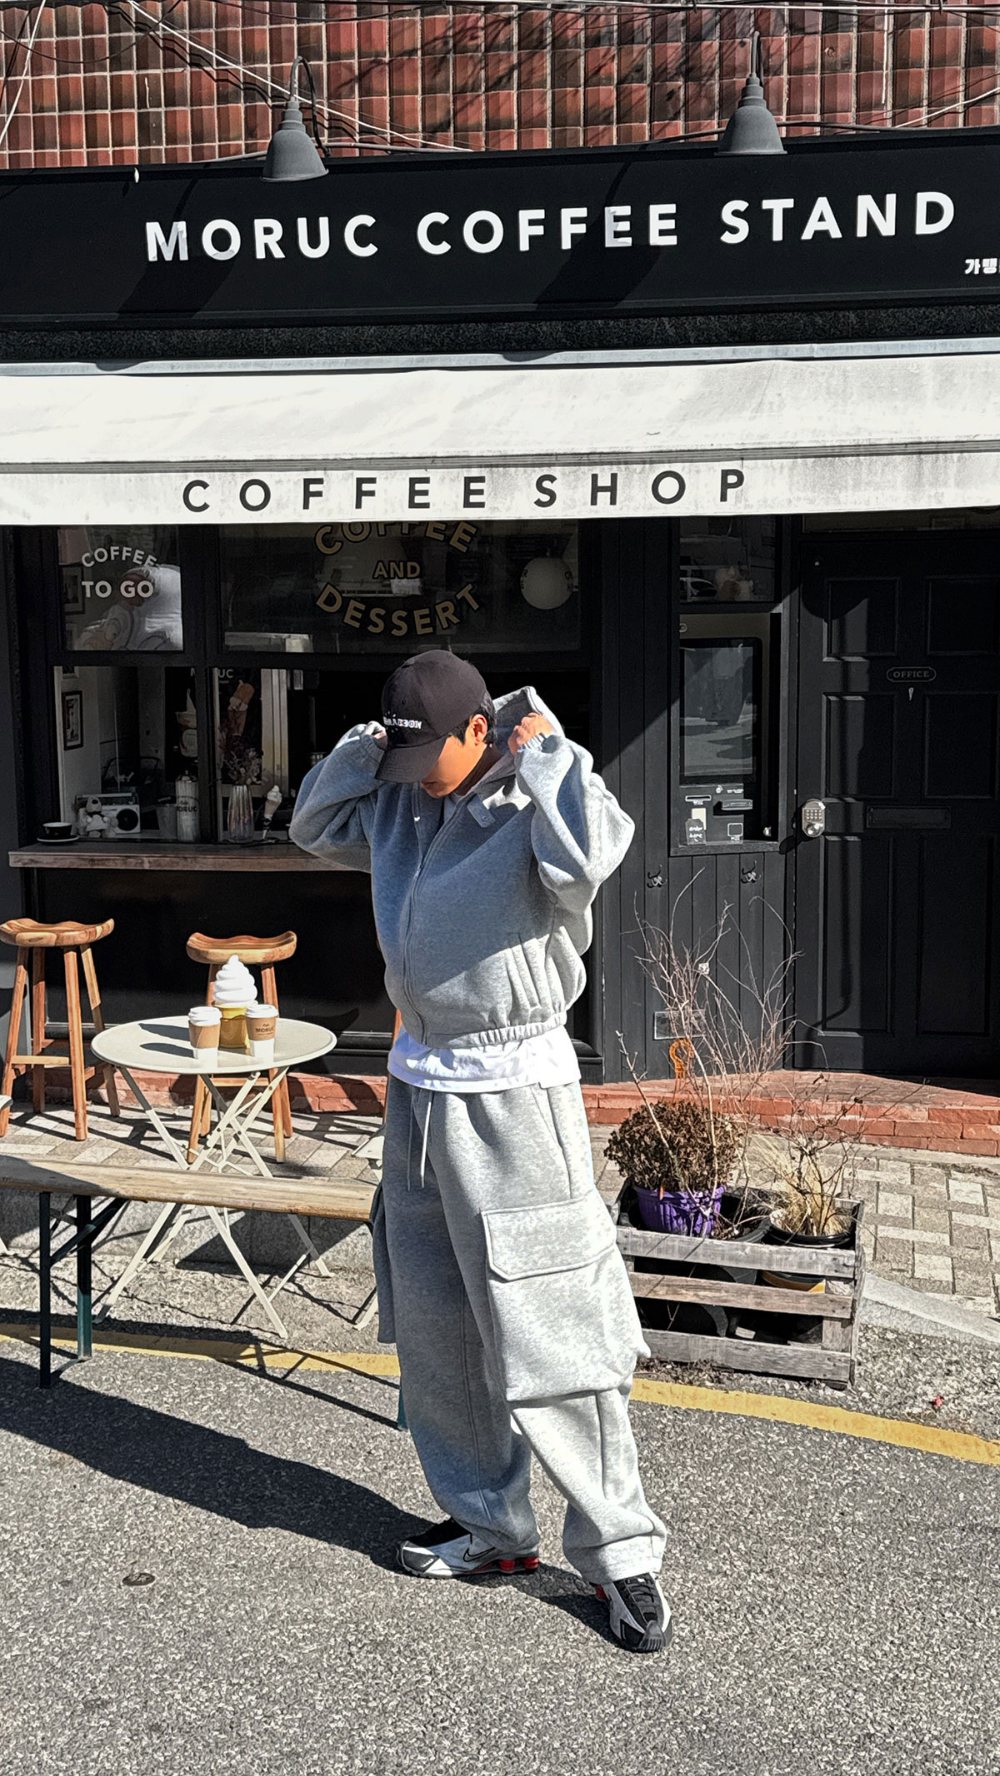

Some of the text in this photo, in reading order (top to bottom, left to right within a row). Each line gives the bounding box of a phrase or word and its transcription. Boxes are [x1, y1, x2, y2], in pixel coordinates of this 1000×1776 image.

[146, 191, 955, 262] MORUC COFFEE STAND
[182, 469, 745, 512] COFFEE SHOP
[81, 546, 157, 568] COFFEE
[372, 561, 421, 579] AND
[81, 580, 154, 598] TO GO
[315, 583, 480, 637] DESSERT
[892, 670, 930, 679] OFFICE
